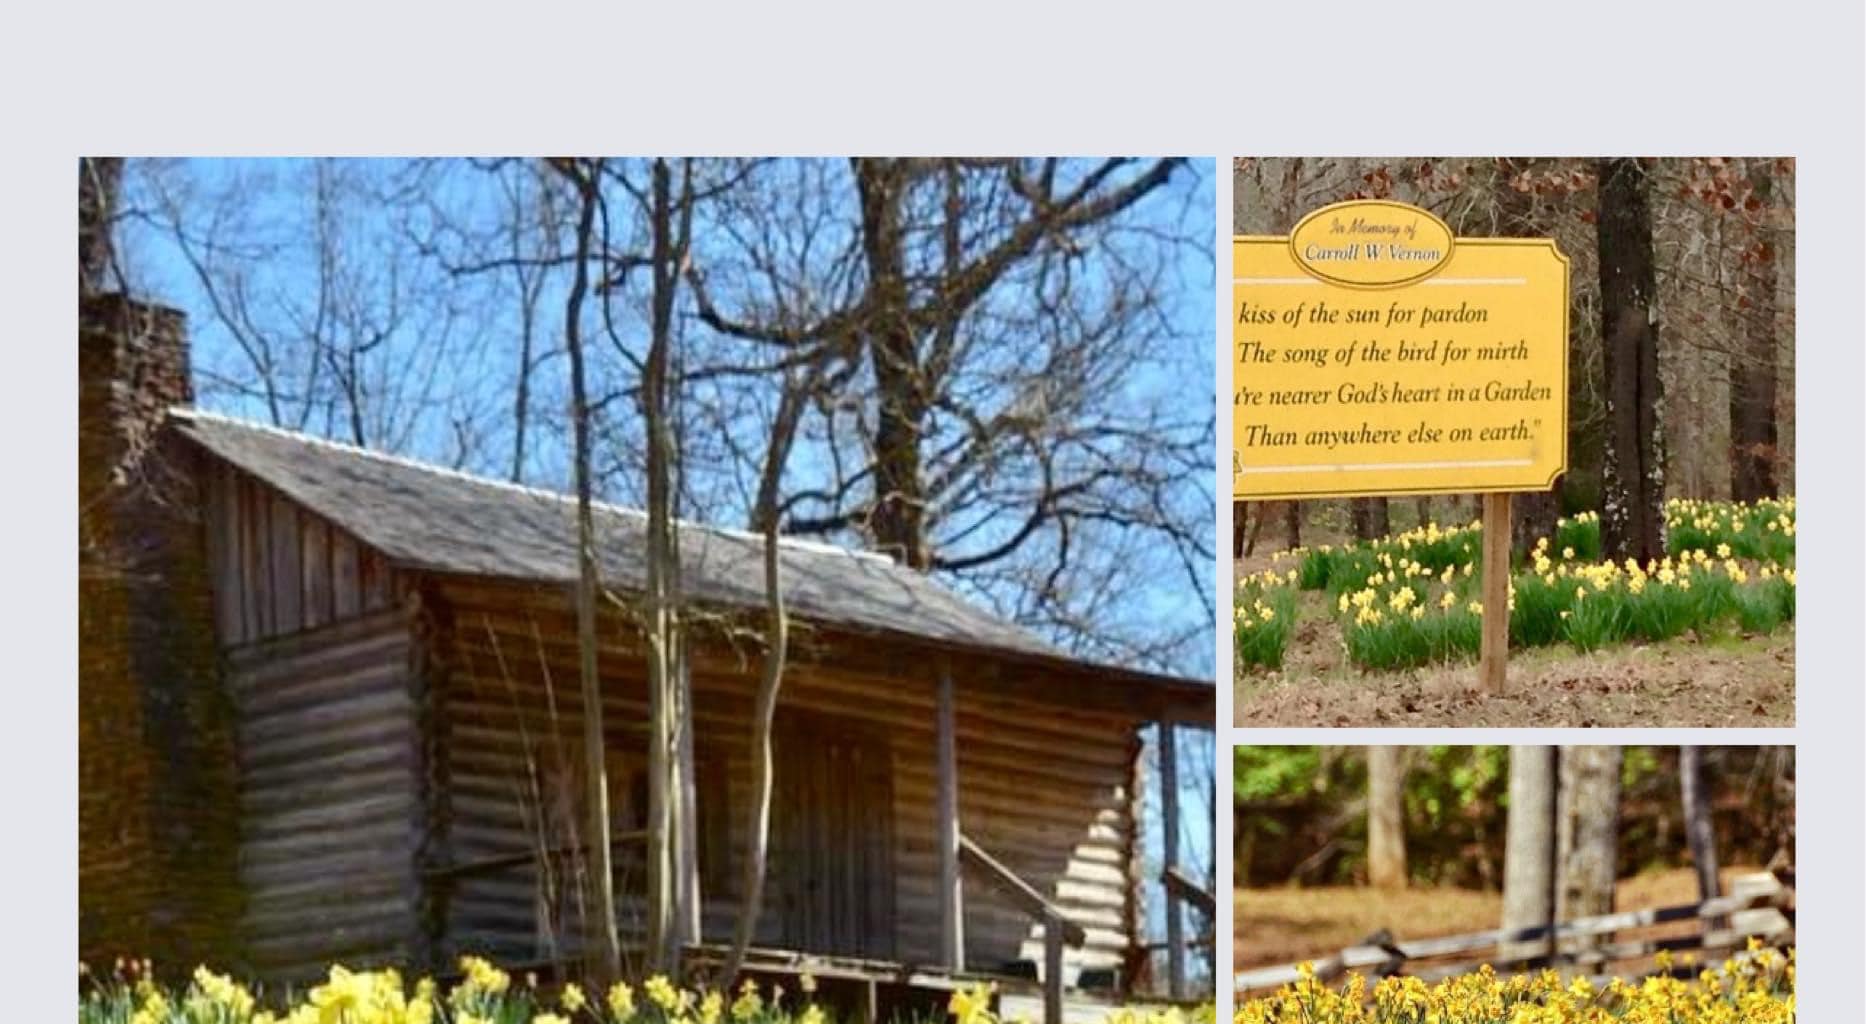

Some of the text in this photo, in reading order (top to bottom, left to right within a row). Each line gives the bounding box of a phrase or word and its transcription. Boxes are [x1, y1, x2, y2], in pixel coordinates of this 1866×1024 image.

[1330, 217, 1418, 240] In Memory of
[1305, 243, 1359, 261] Carroll
[1389, 244, 1441, 261] Vernon
[1238, 301, 1488, 328] kiss of the sun for pardon
[1238, 338, 1528, 368] The song of the bird for mirth
[1269, 389, 1332, 405] nearer
[1338, 382, 1388, 404] God's
[1391, 381, 1441, 403] heart
[1447, 382, 1465, 401] in
[1469, 388, 1480, 402] a
[1485, 379, 1552, 402] Garden
[1245, 424, 1297, 447] Than
[1305, 422, 1401, 450] anywhere
[1407, 421, 1443, 443] else
[1449, 428, 1472, 441] on
